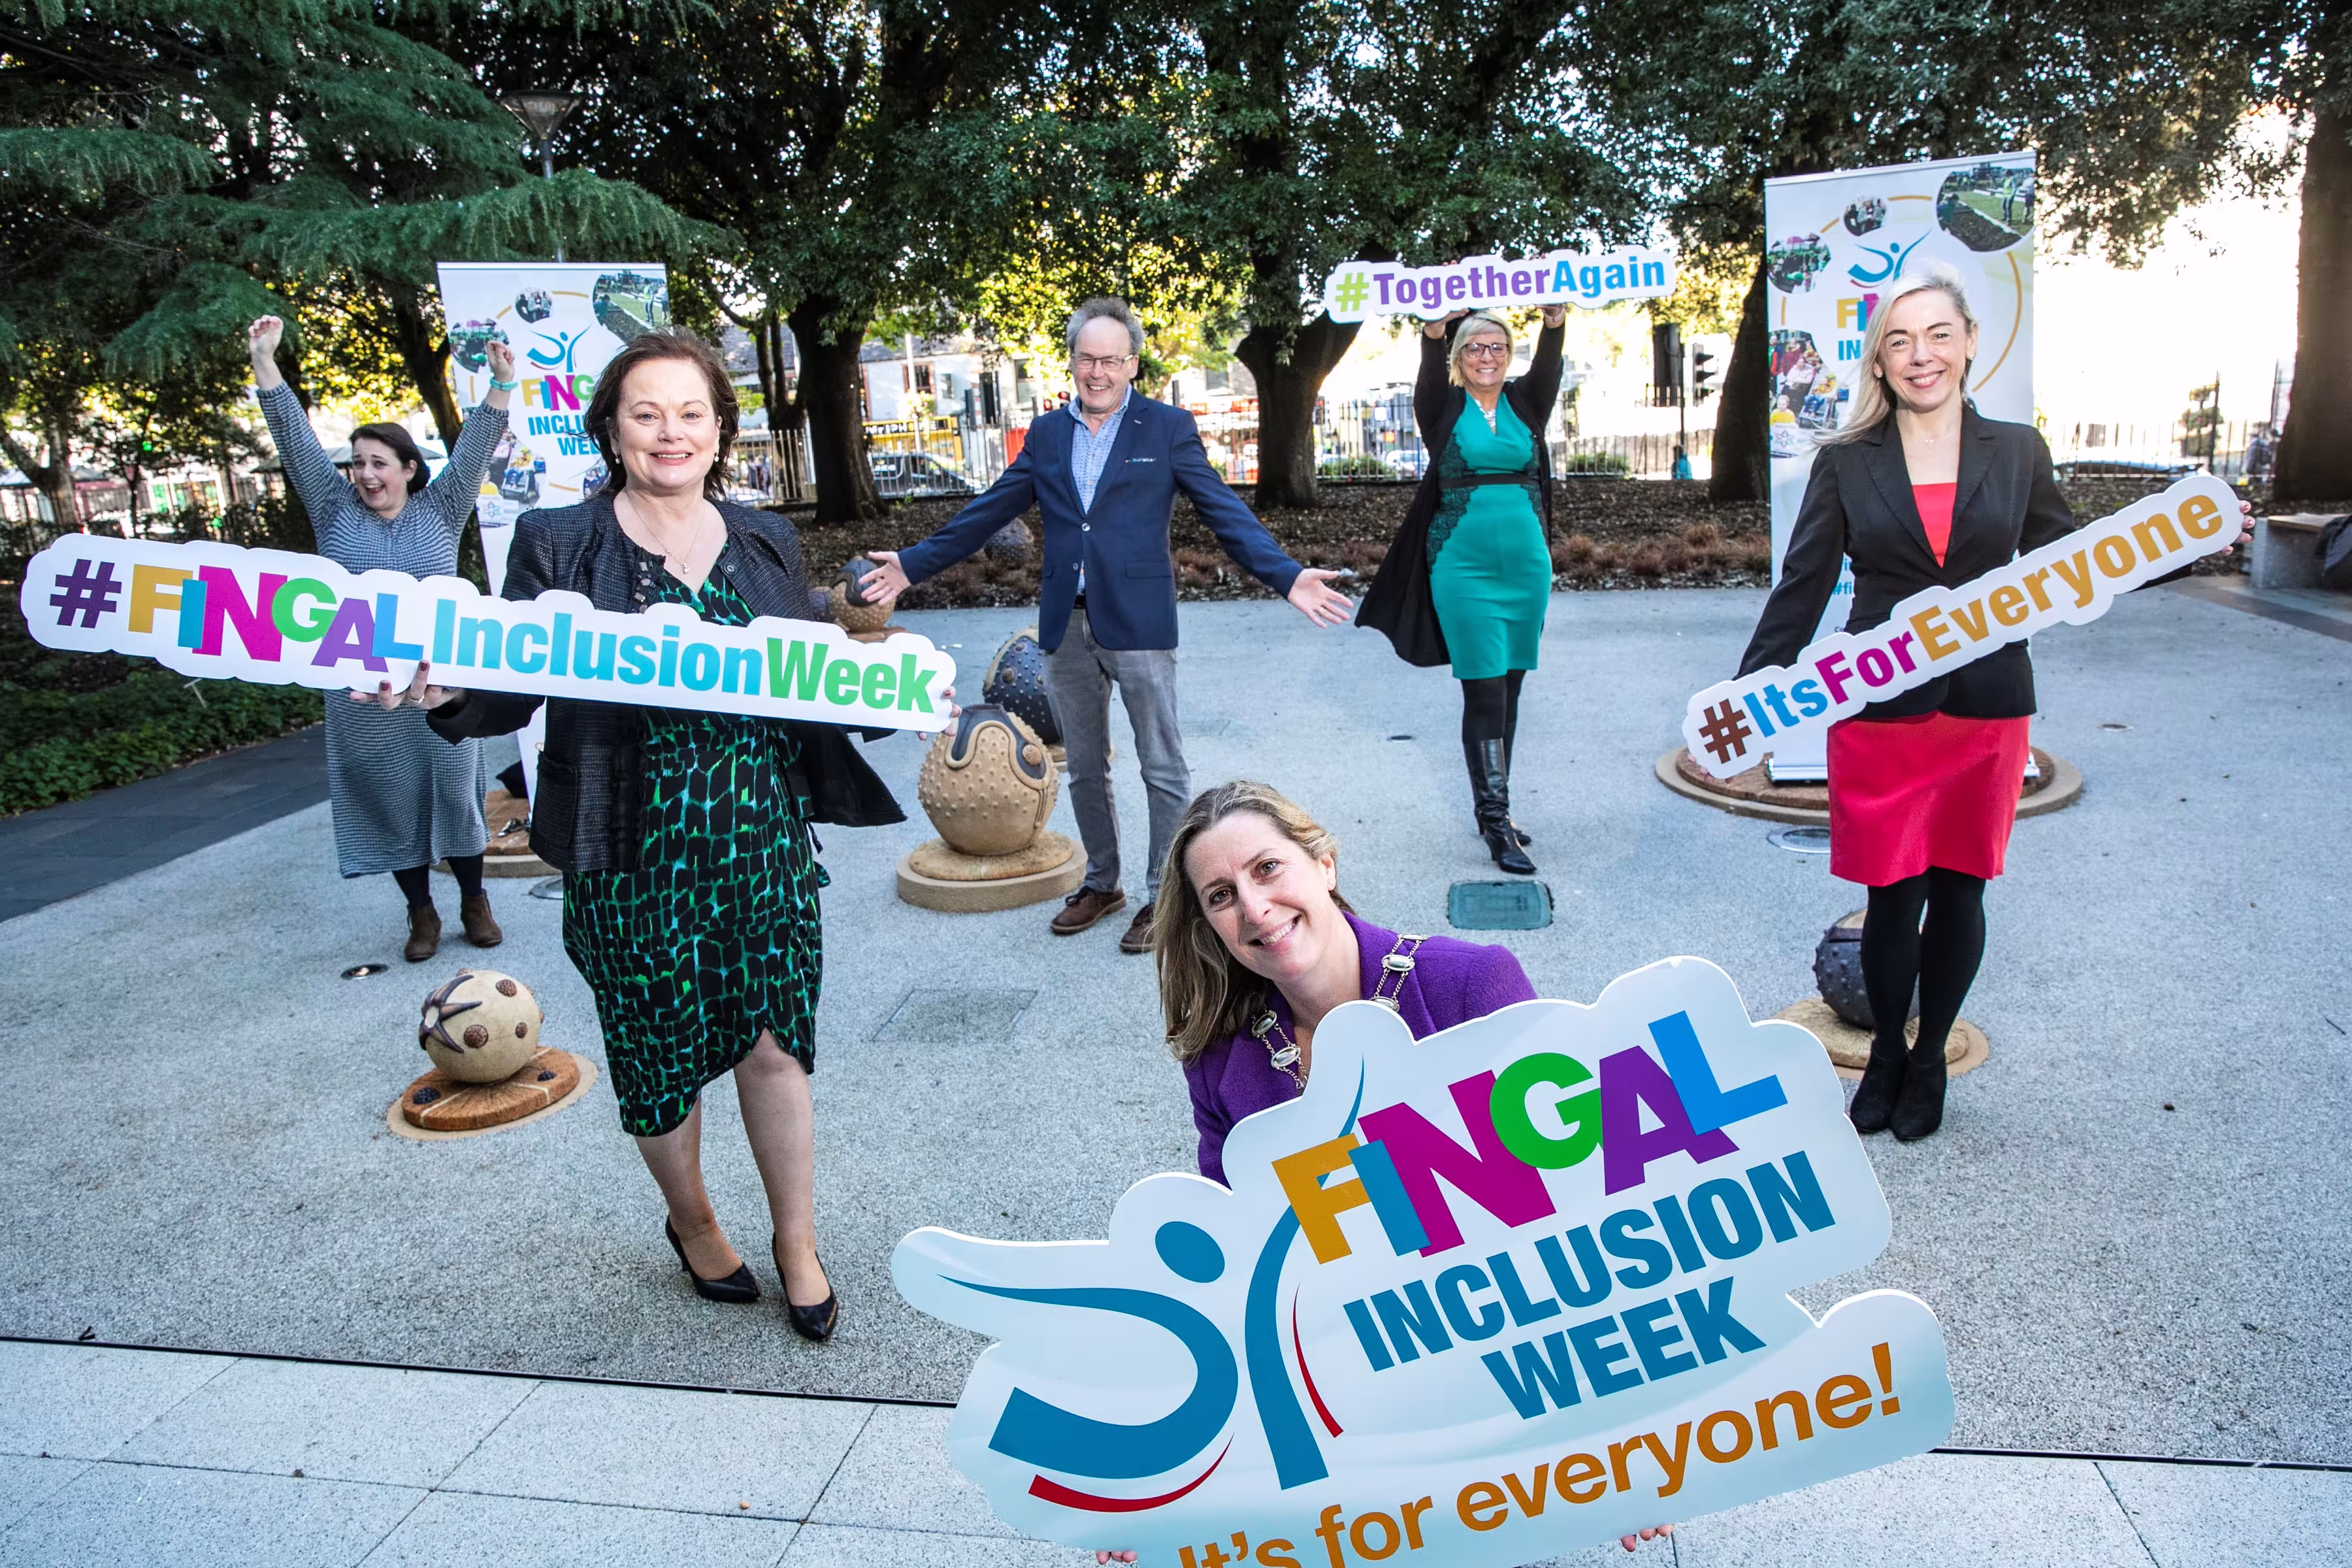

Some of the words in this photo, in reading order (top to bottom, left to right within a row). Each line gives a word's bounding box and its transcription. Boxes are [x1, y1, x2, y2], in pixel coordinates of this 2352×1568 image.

[1335, 255, 1665, 312] #TogetherAgain
[50, 559, 937, 713] #FINGALInclusionWeek
[1699, 494, 2222, 764] #ItsForEveryone
[1271, 1010, 1788, 1265] FINGAL
[1343, 1150, 1836, 1372] INCLUSION
[1480, 1276, 1767, 1420] WEEK
[1315, 1495, 1433, 1568] for
[1456, 1342, 1904, 1531] everyone!
